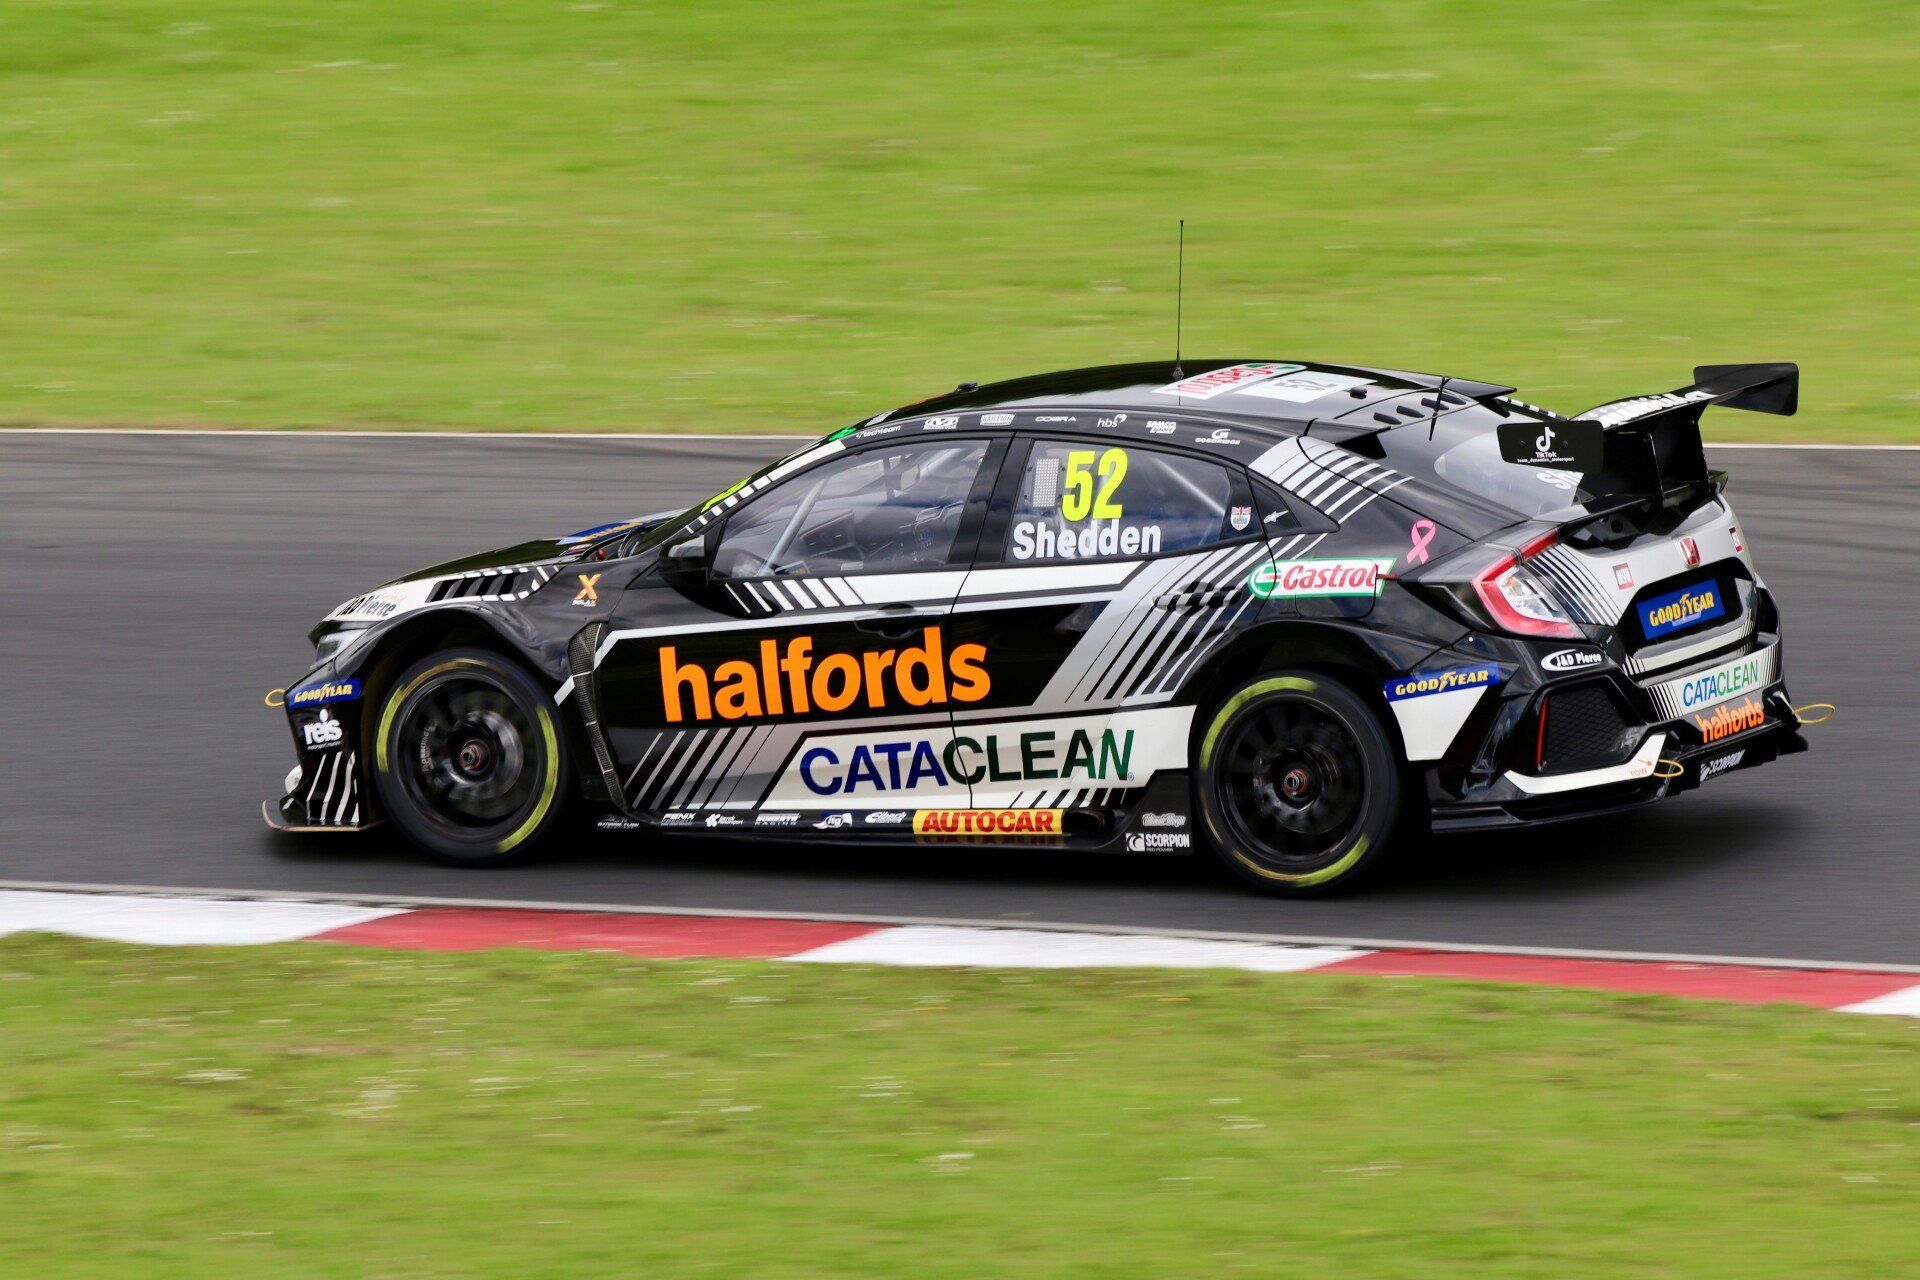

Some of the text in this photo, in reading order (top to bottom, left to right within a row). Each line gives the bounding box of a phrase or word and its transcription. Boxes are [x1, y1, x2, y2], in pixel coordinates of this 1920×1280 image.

[863, 424, 902, 438] techteam
[1097, 416, 1118, 428] hbs
[1145, 420, 1177, 428] SAMCO
[1195, 437, 1241, 445] GOODRIDGE
[1062, 448, 1128, 521] 52
[1012, 519, 1161, 560] Shedden
[1282, 561, 1378, 589] Castrol
[356, 594, 397, 617] Pierce
[1556, 652, 1602, 667] J&D Pierce
[658, 627, 992, 722] halfords
[1682, 659, 1759, 708] CATACLEAN
[303, 708, 343, 745] reis
[1694, 697, 1765, 744] halfords
[800, 729, 1135, 796] CATACLEAN
[1629, 767, 1648, 778] TOW
[663, 812, 697, 820] FENIX
[921, 811, 1054, 833] AUTOCAR
[1145, 833, 1191, 848] SCORPION
